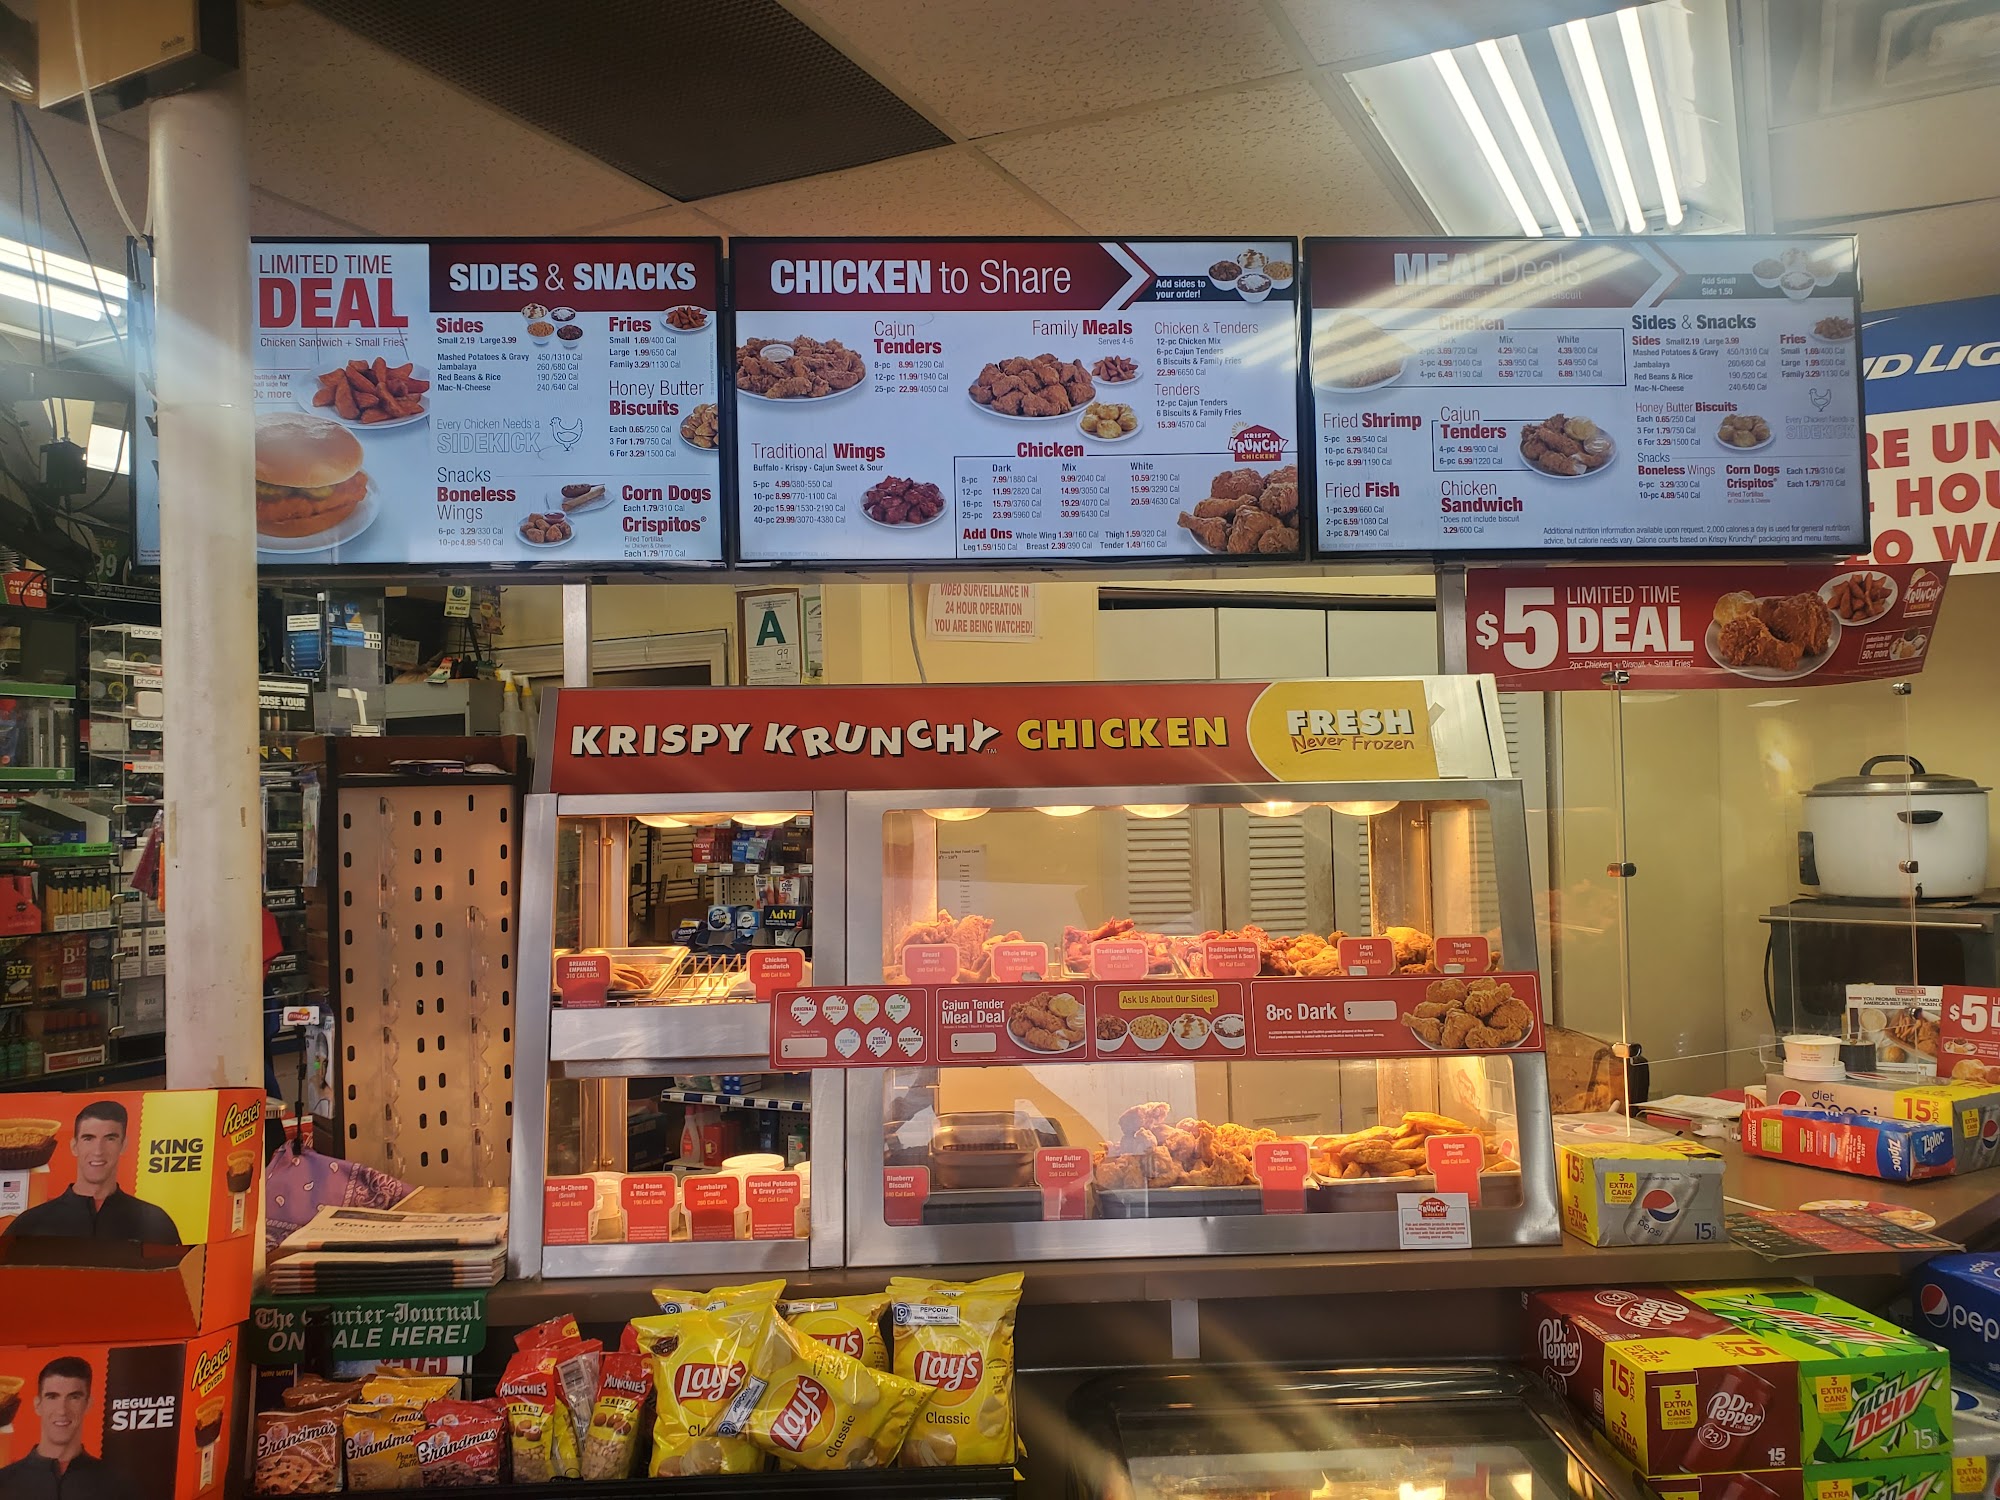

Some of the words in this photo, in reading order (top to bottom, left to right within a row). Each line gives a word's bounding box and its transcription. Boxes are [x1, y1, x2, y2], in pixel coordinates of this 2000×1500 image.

[259, 255, 338, 274] LIMITED
[344, 254, 392, 274] TIME
[1394, 253, 1496, 285] MEAL
[1500, 253, 1581, 286] Deals
[449, 263, 538, 291] SIDES
[544, 263, 565, 291] &
[573, 263, 697, 291] SNACKS
[770, 259, 932, 294] CHICKEN
[938, 261, 969, 294] to
[980, 259, 1071, 294] Share
[1156, 279, 1172, 288] Add
[1174, 279, 1195, 288] sides
[1197, 279, 1206, 288] to
[258, 277, 408, 328] DEAL
[1156, 290, 1174, 300] your
[1176, 289, 1201, 298] order!
[436, 317, 483, 333] Sides
[609, 316, 652, 332] Fries
[874, 320, 915, 339] Cajun
[1032, 319, 1078, 338] Family
[1082, 319, 1133, 335] Meals
[1154, 322, 1199, 335] Chicken
[1202, 322, 1210, 334] &
[1214, 321, 1259, 334] Tenders
[1632, 314, 1676, 330] Sides
[1681, 314, 1692, 330] &
[1696, 314, 1757, 329] Snacks
[260, 338, 296, 347] Chicken
[299, 338, 343, 347] Sandwich
[345, 339, 352, 347] +
[355, 338, 380, 347] Small
[873, 338, 942, 354] Tenders
[437, 353, 467, 361] Mashed
[468, 353, 500, 361] Potatoes
[501, 353, 507, 361] &
[508, 353, 530, 363] Gravy
[437, 363, 477, 371] Jambalaya
[609, 380, 654, 398] Honey
[660, 380, 704, 396] Butter
[609, 400, 679, 416] Biscuits
[1440, 406, 1480, 424] Cajun
[437, 418, 463, 431] Every
[464, 418, 500, 429] Chicken
[502, 418, 532, 429] Needs
[534, 420, 540, 429] a
[1323, 413, 1358, 429] Fried
[1362, 412, 1422, 431] Shrimp
[1440, 424, 1507, 439] Tenders
[437, 432, 541, 453] SIDEKICK
[1017, 442, 1084, 458] Chicken
[1228, 437, 1289, 453] KRUNCHY
[751, 443, 828, 459] Traditional
[833, 443, 886, 462] Wings
[437, 466, 491, 483] Snacks
[437, 486, 516, 502] Boneless
[622, 484, 666, 501] Corn
[668, 484, 711, 504] Dogs
[1325, 482, 1360, 498] Fried
[1365, 482, 1400, 498] Fish
[1441, 480, 1497, 496] Chicken
[1441, 497, 1523, 512] Sandwich
[437, 504, 483, 523] Wings
[963, 528, 988, 541] Add
[990, 528, 1013, 541] Ons
[939, 583, 962, 597] VIDEO
[963, 583, 1019, 598] SURVEILLANCE
[1020, 584, 1029, 598] IN
[1567, 586, 1635, 604] LIMITED
[1639, 585, 1680, 604] TIME
[945, 601, 955, 614] 24
[956, 601, 978, 615] HOUR
[979, 601, 1023, 615] OPERATION
[132, 628, 159, 638] iphone
[756, 610, 786, 646] A
[934, 619, 951, 633] YOU
[952, 619, 968, 633] ARE
[969, 619, 993, 633] BEING
[994, 619, 1034, 634] WATCHED!
[1567, 606, 1694, 654] DEAL
[1653, 660, 1674, 668] Small
[282, 696, 306, 707] YOUR
[1285, 708, 1415, 736] FRESH
[571, 722, 753, 758] KRISPY
[763, 718, 1001, 760] KRUNCHY
[1015, 716, 1229, 752] CHICKEN
[1291, 735, 1346, 754] Never
[1351, 735, 1415, 751] Frozen
[769, 909, 796, 919] Advil
[1359, 943, 1373, 952] Legs
[1453, 942, 1471, 950] Thighs
[762, 962, 790, 971] Sandwich
[765, 956, 787, 964] Chicken
[6, 965, 33, 976] 357
[941, 1000, 969, 1011] Cajun
[971, 999, 1005, 1010] Tender
[1122, 995, 1136, 1005] Ask
[1138, 995, 1148, 1005] Us
[1149, 995, 1172, 1005] About
[1174, 995, 1189, 1005] Our
[1191, 994, 1216, 1004] Sides!
[941, 1010, 972, 1024] Meal
[974, 1009, 1005, 1023] Deal
[1297, 1002, 1338, 1020] Dark
[1811, 1090, 1835, 1102] diet
[1902, 1097, 1931, 1122] 15
[222, 1099, 262, 1137] Reese's
[235, 1128, 253, 1144] LOVERS
[1921, 1131, 1946, 1153] Ziploc
[150, 1137, 204, 1155] KING
[1045, 1155, 1062, 1163] Honey
[1063, 1154, 1082, 1162] Butter
[1887, 1137, 1902, 1172] Ziploc
[148, 1155, 202, 1173] SIZE
[696, 1183, 727, 1191] Jambalaya
[772, 1180, 797, 1188] Potatoes
[1609, 1182, 1635, 1190] EXTRA
[1637, 1219, 1664, 1238] pepsi
[1694, 1222, 1712, 1240] 15
[255, 1307, 294, 1331] The
[332, 1327, 384, 1349] ALE
[390, 1324, 471, 1347] HERE!
[191, 1340, 232, 1391] Reese's
[918, 1349, 981, 1392] Lay's
[604, 1372, 647, 1394] MUNCHIES
[679, 1362, 747, 1402] Lay's
[1609, 1358, 1630, 1398] 15
[500, 1381, 547, 1398] MUNCHIES
[1820, 1386, 1849, 1395] EXTRA
[112, 1395, 176, 1411] REGULAR
[1663, 1400, 1693, 1409] EXTRA
[1708, 1392, 1762, 1428] Pepper
[111, 1407, 175, 1431] SIZE
[770, 1375, 821, 1450] Lay's
[925, 1410, 971, 1425] Classic
[1666, 1408, 1692, 1417] CANS
[257, 1420, 337, 1459] Grandma's
[415, 1428, 499, 1466] Grandma's
[1913, 1428, 1933, 1450] 15
[1767, 1448, 1786, 1462] 15
